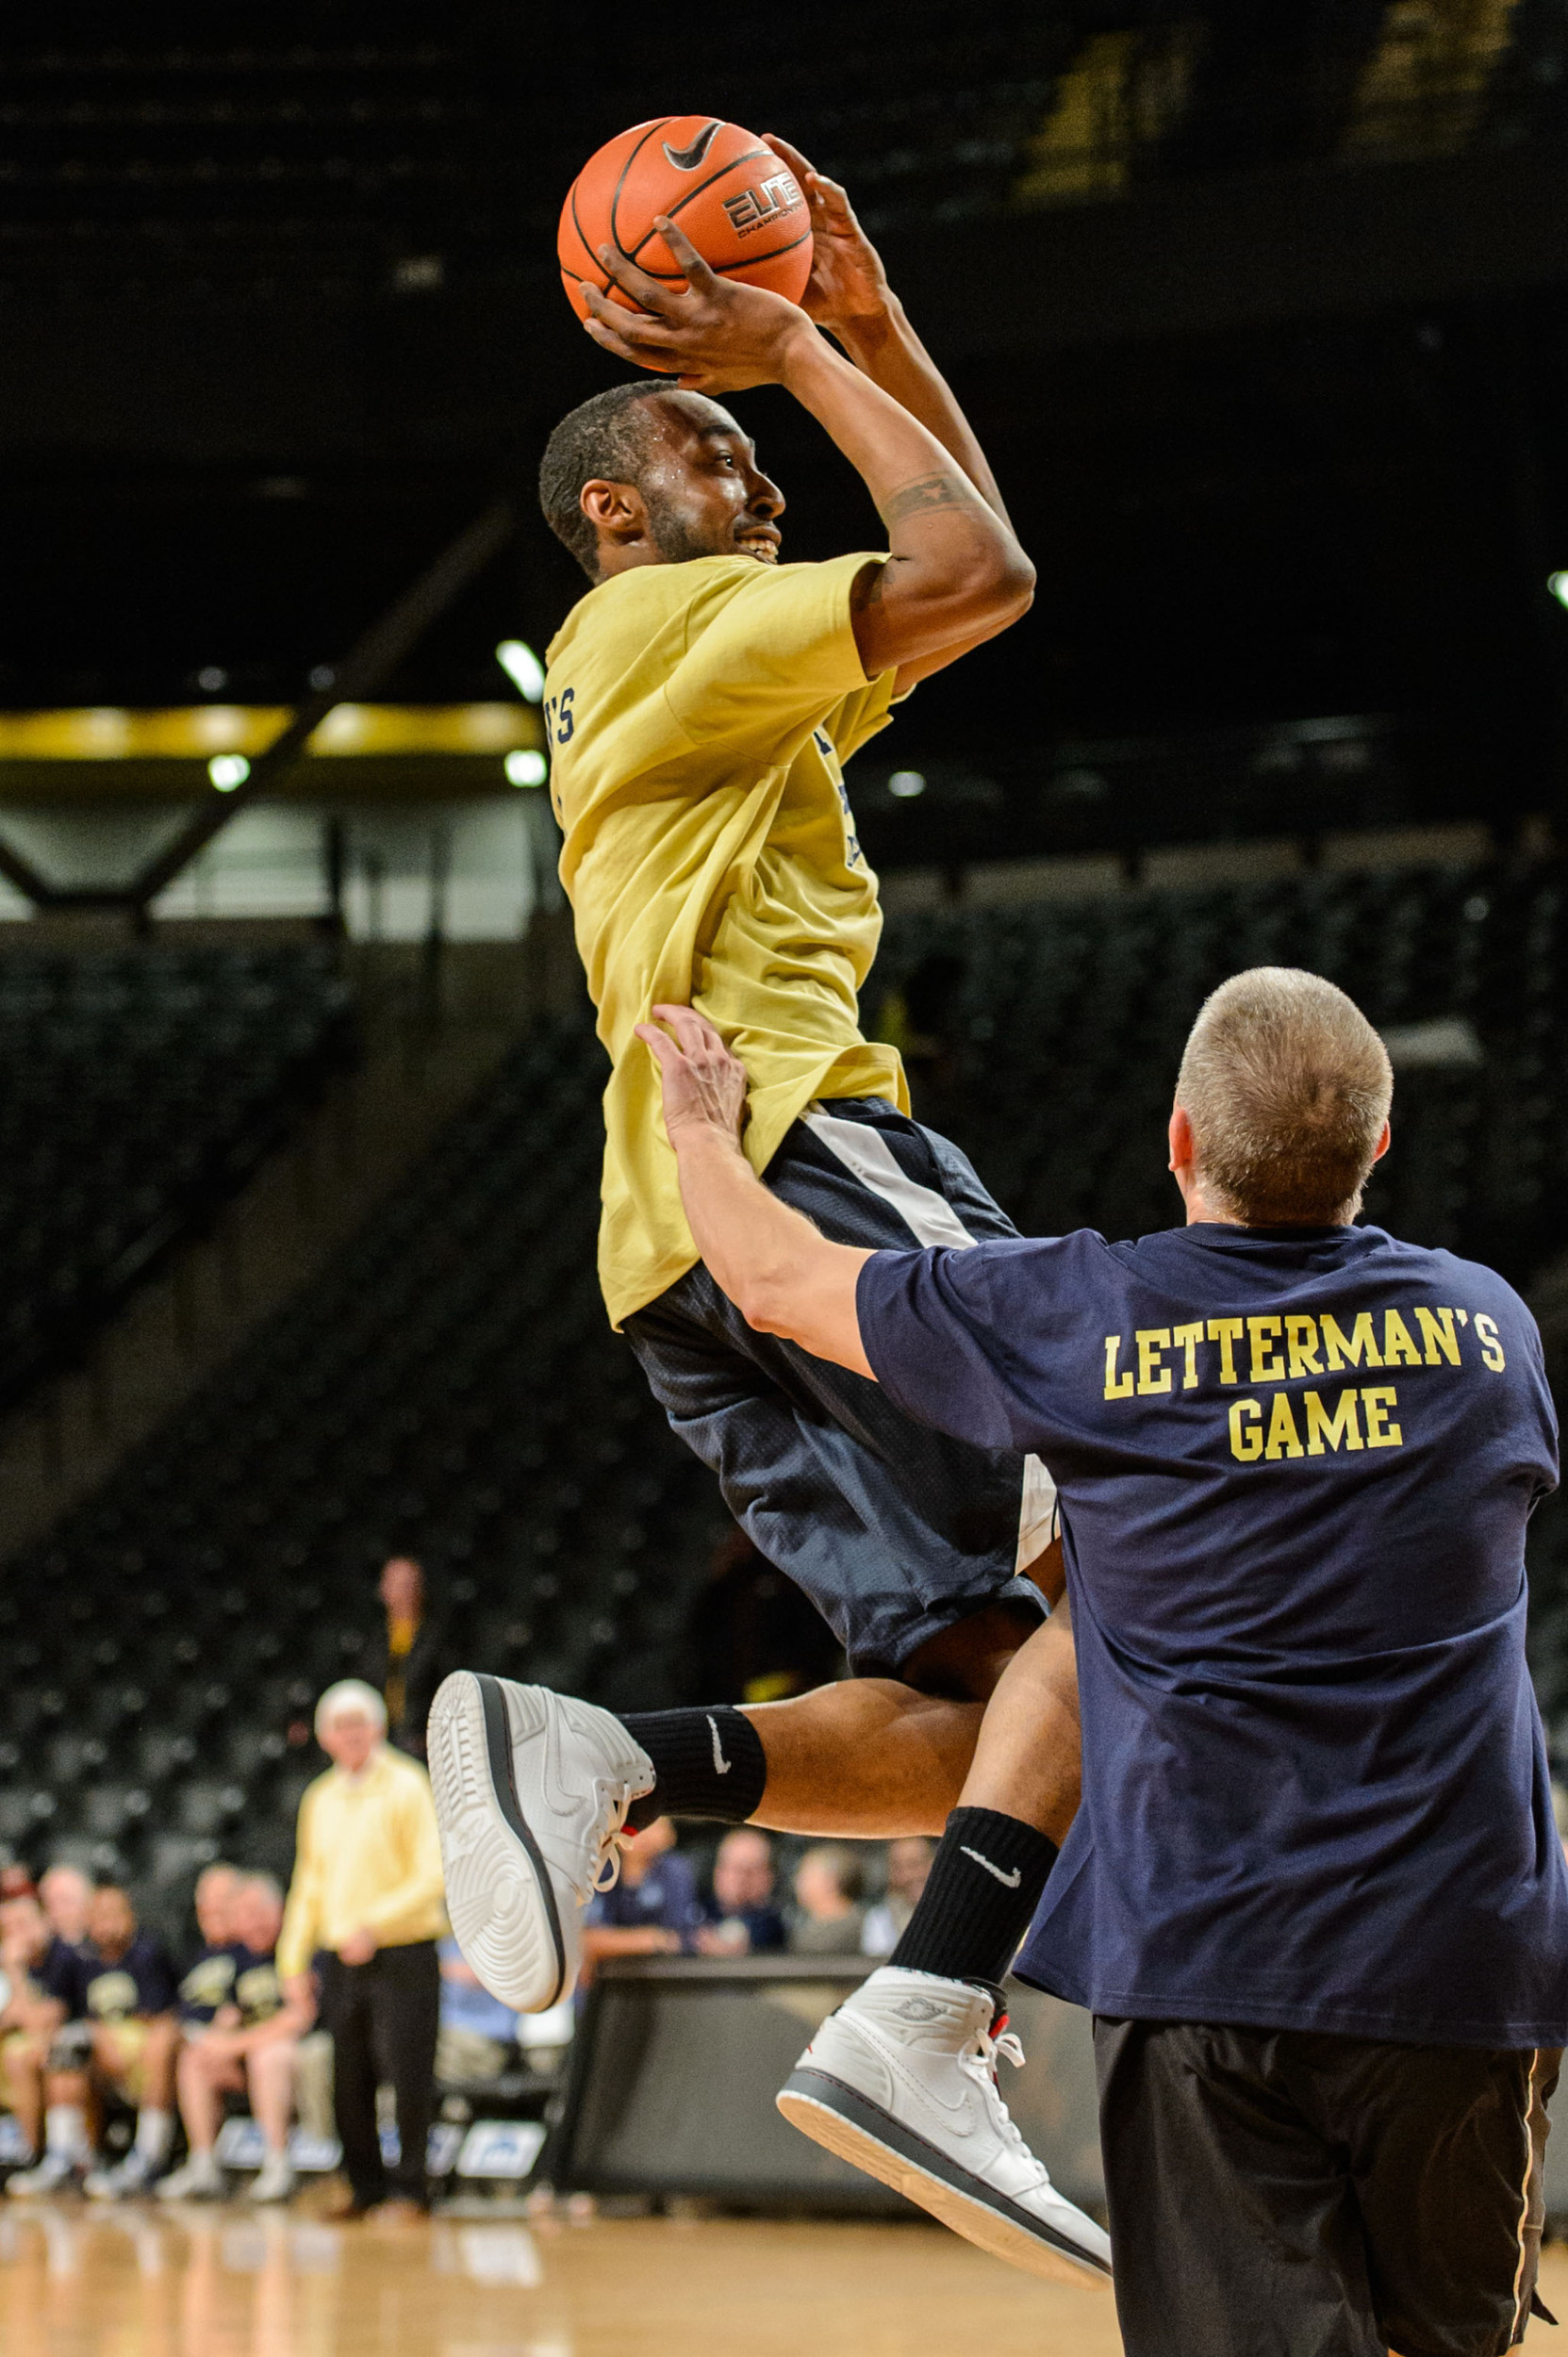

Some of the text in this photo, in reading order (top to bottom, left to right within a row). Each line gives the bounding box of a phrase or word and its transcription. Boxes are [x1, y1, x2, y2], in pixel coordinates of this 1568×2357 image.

[722, 172, 801, 231] ELITE
[1103, 1307, 1506, 1401] LETTERMAN'S
[1229, 1386, 1403, 1462] GAME
